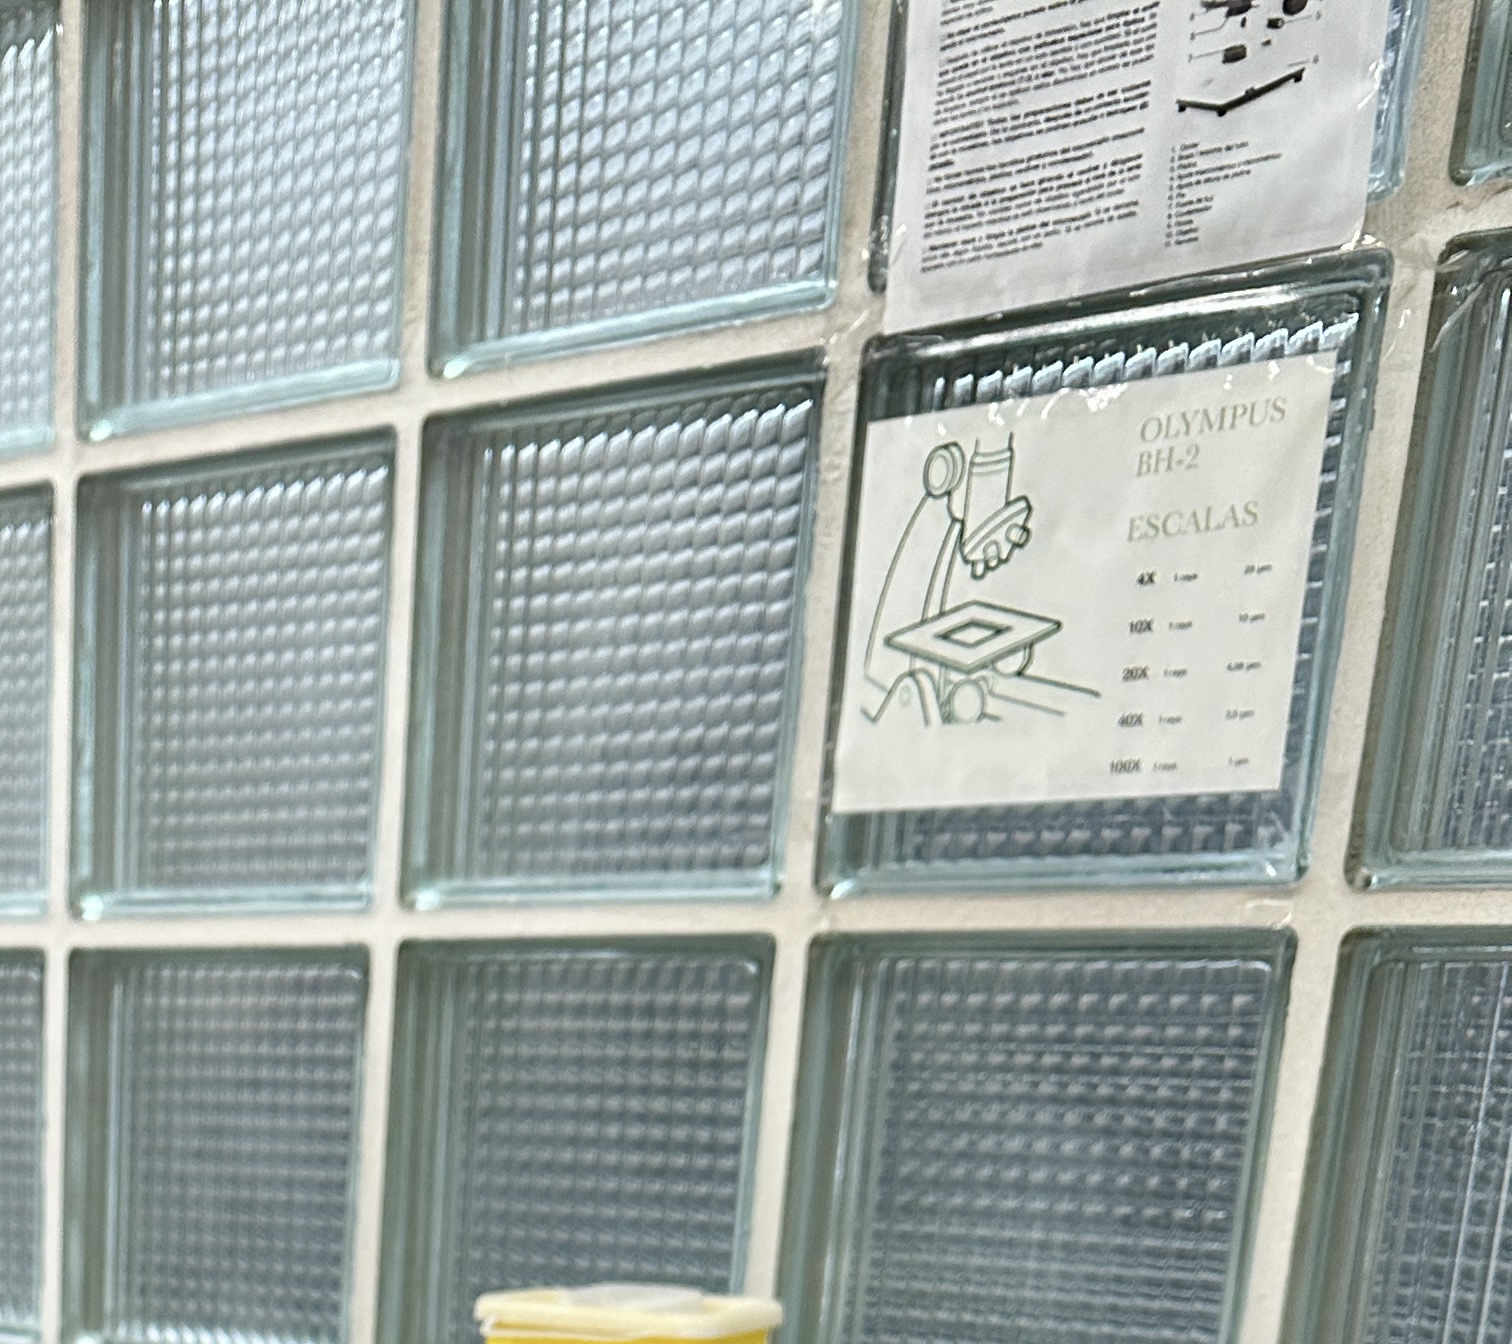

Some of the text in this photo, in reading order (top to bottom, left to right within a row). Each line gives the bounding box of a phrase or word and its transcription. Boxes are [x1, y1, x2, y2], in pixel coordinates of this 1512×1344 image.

[1140, 396, 1287, 443] OLYMPUS
[1136, 443, 1200, 477] BH-2
[1127, 500, 1258, 542] ESCALAS
[1136, 570, 1156, 586] 4X
[1129, 618, 1154, 634] 10X
[1122, 665, 1149, 682] 20X
[1118, 712, 1143, 727] 40X
[1110, 758, 1141, 774] 100X
